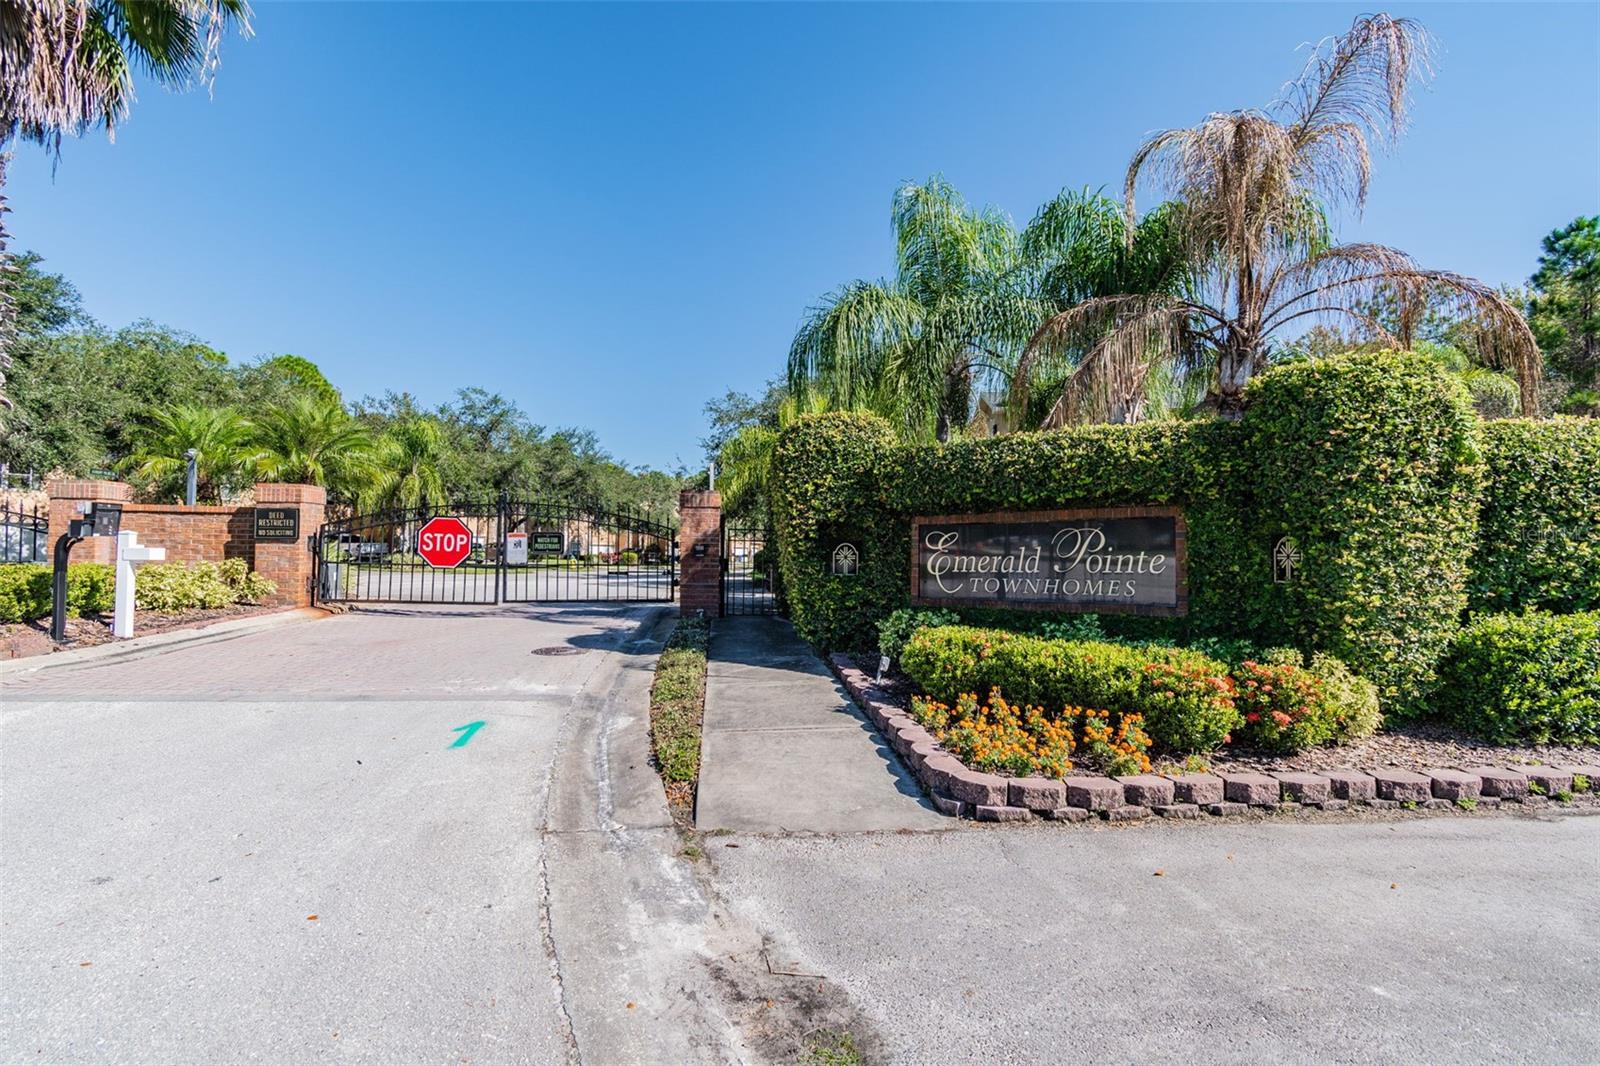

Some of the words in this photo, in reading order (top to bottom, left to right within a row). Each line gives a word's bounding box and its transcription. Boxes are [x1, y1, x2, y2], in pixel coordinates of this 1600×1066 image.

[258, 519, 295, 527] RESTRICTED
[268, 511, 285, 519] DEED
[422, 532, 468, 552] STOP
[925, 531, 1042, 593] Emerald
[1051, 527, 1167, 574] Pointe
[969, 577, 1137, 597] TOWNHOMES
